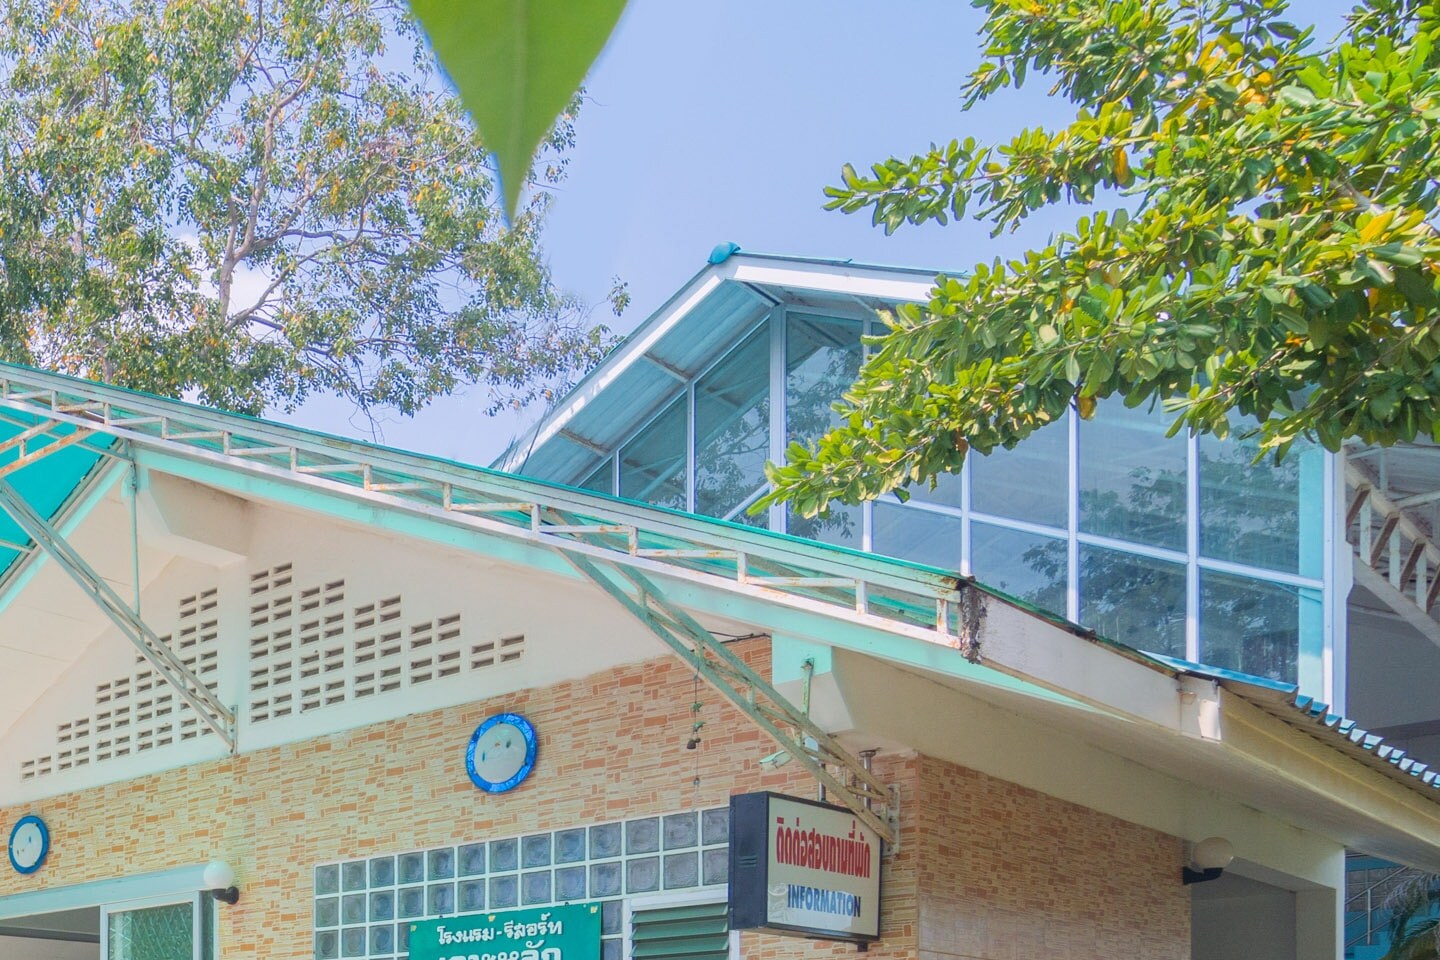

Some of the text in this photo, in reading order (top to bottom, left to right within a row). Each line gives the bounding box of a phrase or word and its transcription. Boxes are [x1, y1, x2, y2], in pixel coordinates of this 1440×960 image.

[776, 816, 871, 879] ติดต่อสอบถามที่พัก
[787, 884, 862, 918] INFORMATION
